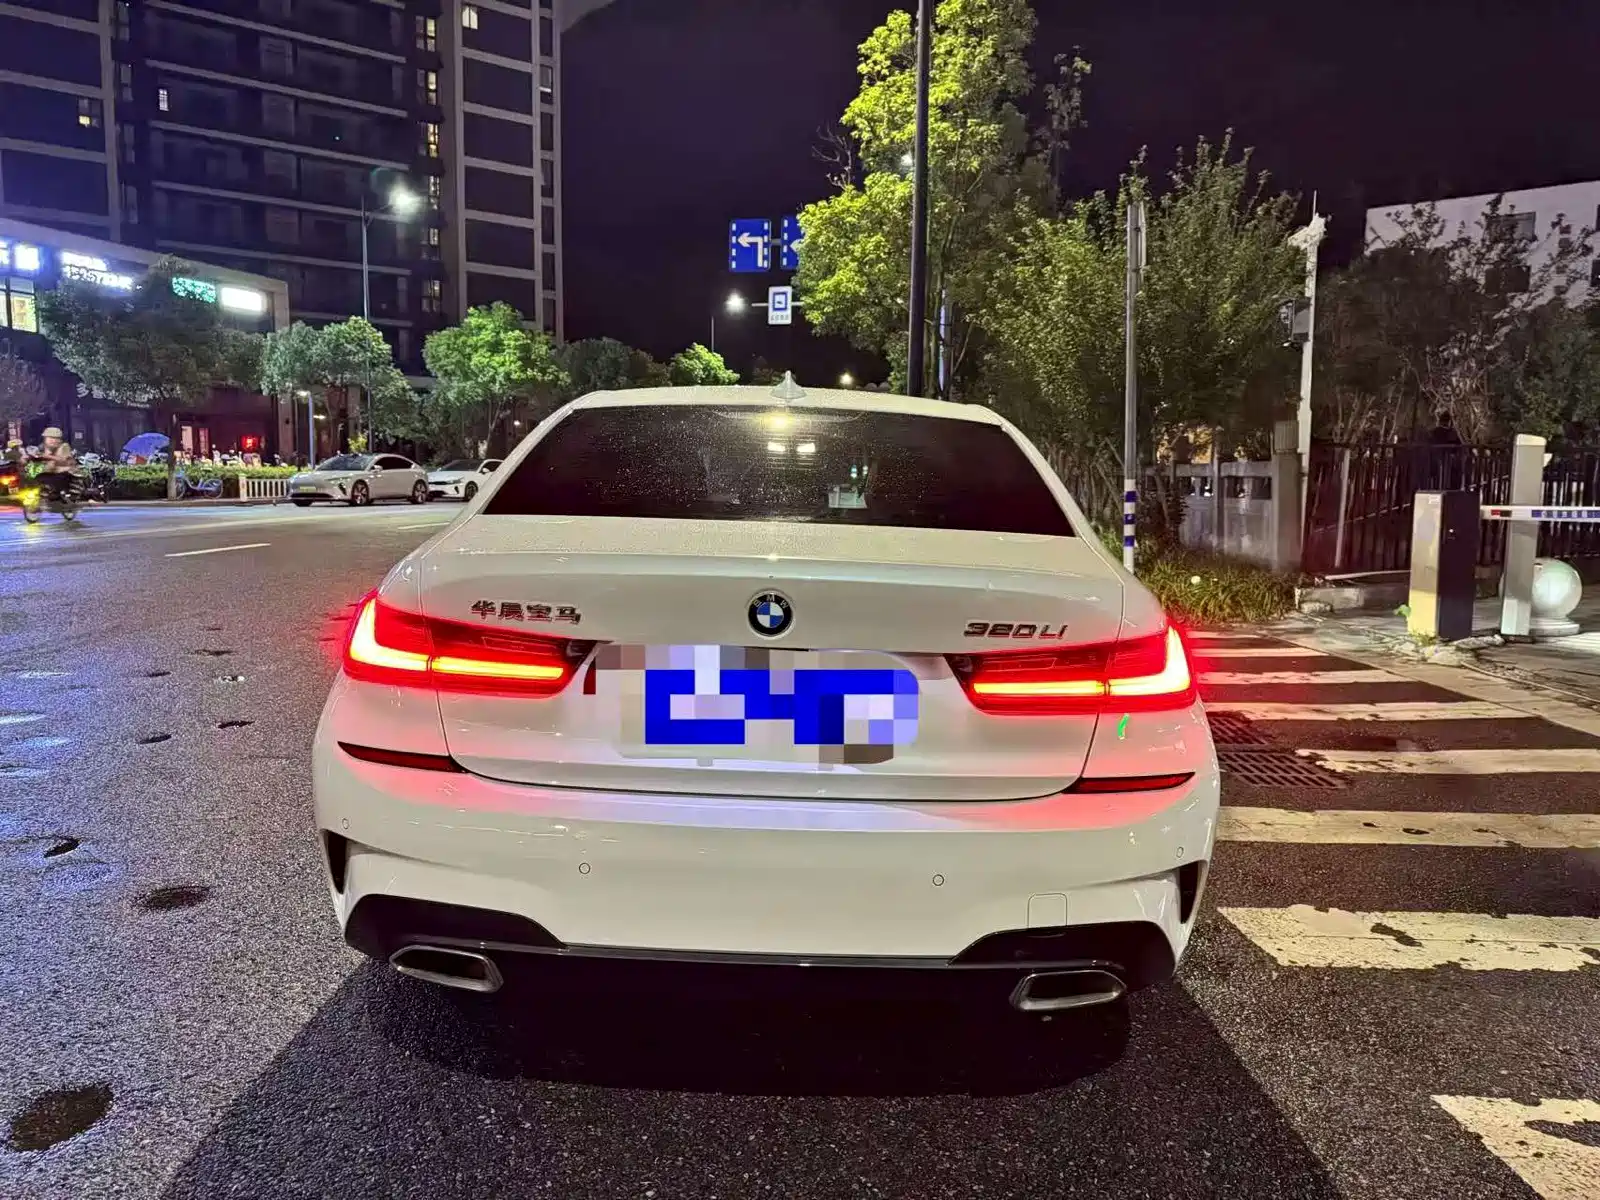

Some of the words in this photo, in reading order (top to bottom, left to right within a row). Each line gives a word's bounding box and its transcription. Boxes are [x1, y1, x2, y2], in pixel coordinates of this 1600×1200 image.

[753, 594, 789, 609] BMW
[471, 600, 582, 625] 华晨宝马
